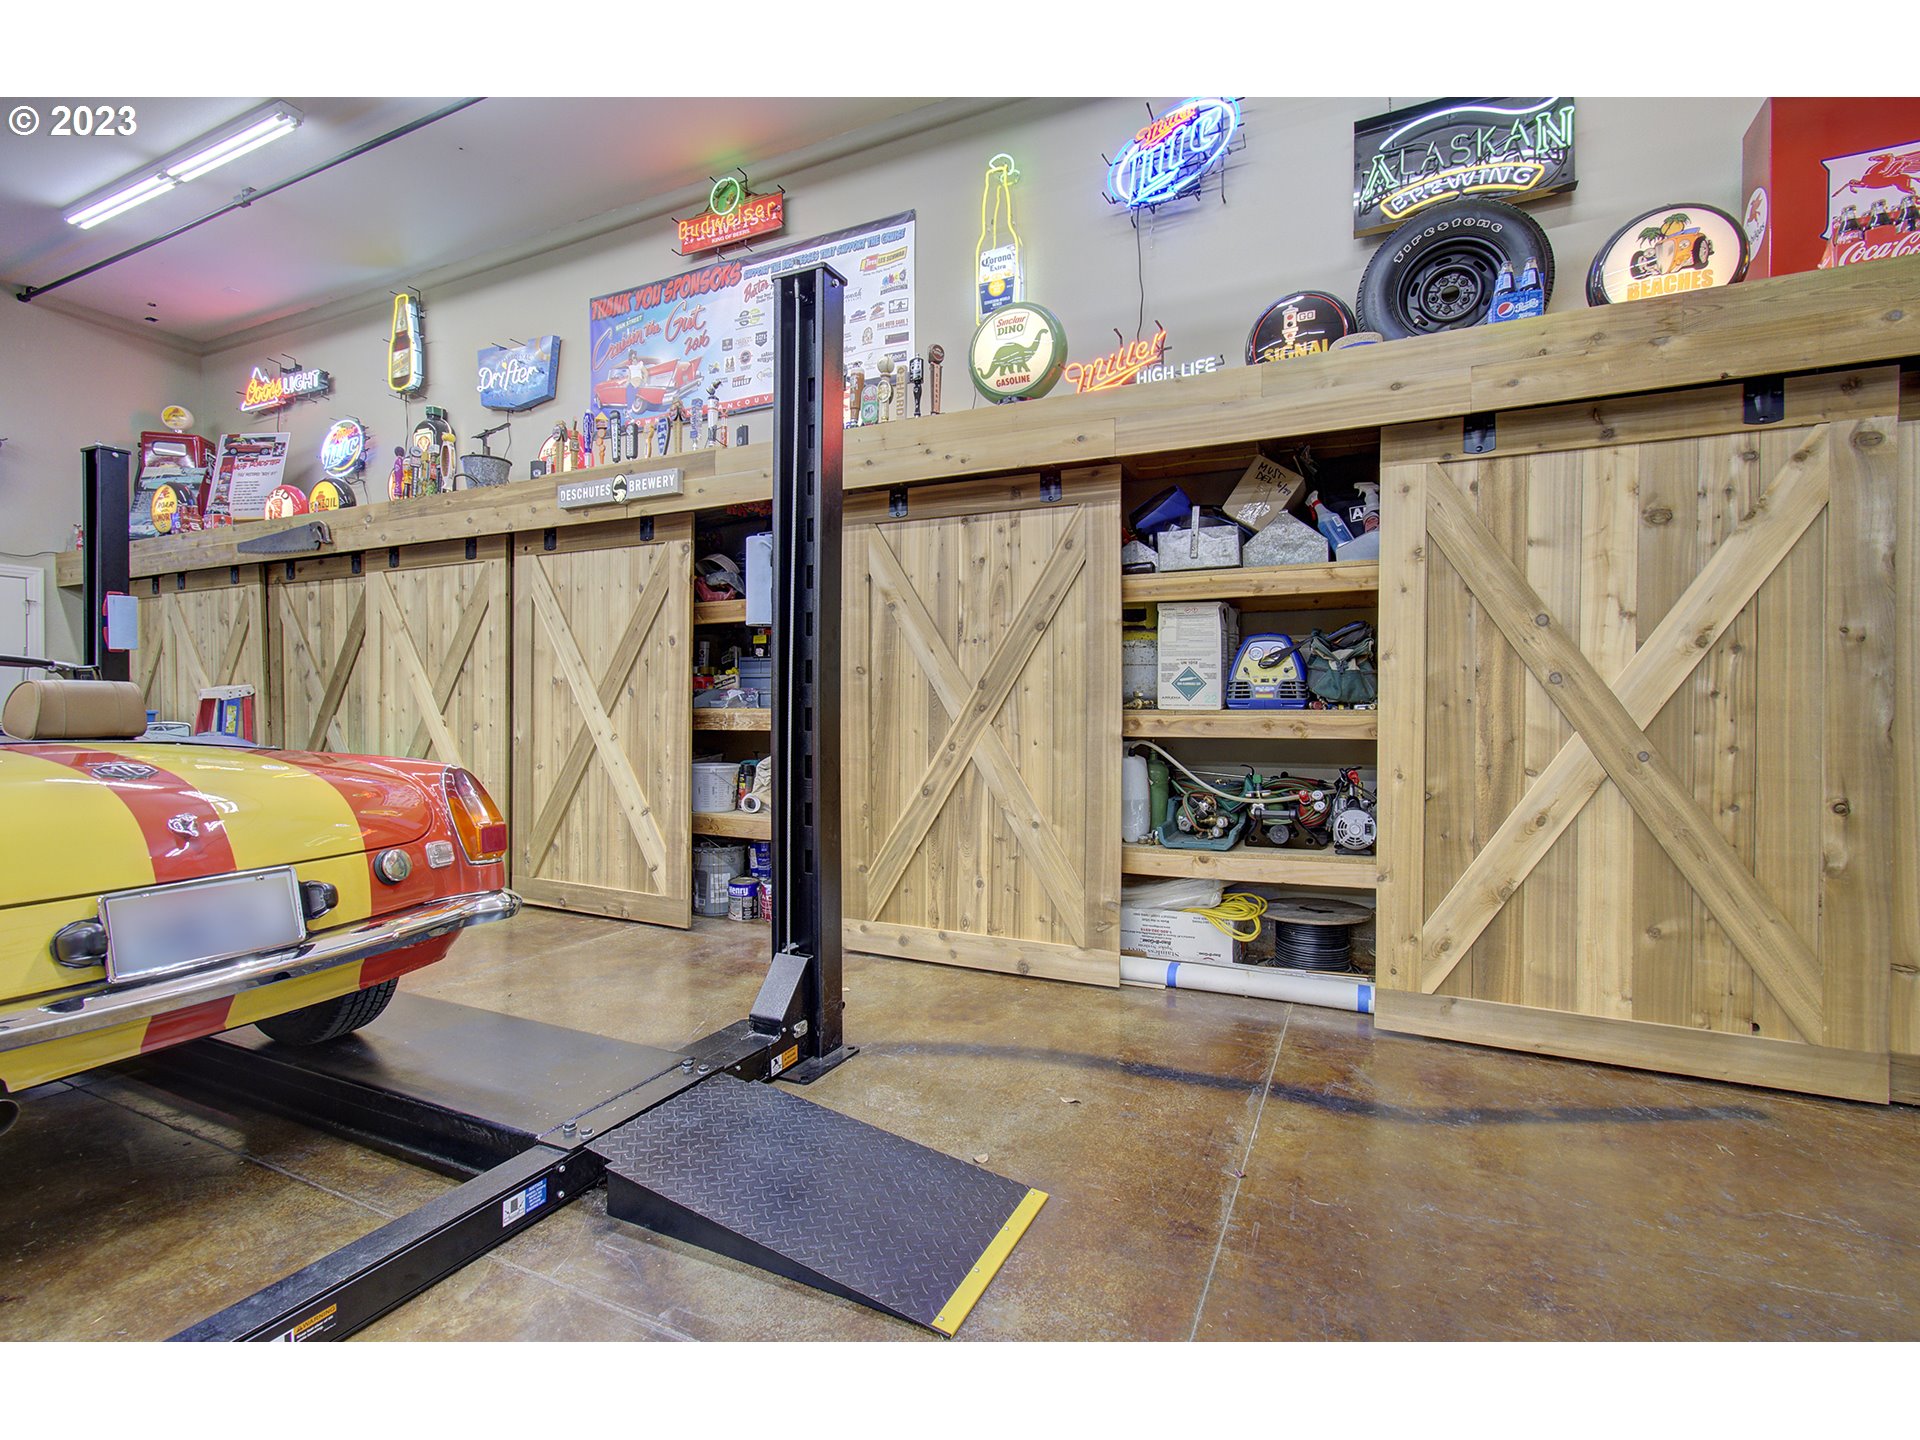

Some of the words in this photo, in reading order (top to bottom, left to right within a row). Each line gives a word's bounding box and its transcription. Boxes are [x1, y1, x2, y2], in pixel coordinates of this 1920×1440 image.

[1360, 107, 1574, 203] ALASKAN
[1391, 166, 1534, 212] BREWING
[678, 201, 776, 239] Budweiser
[867, 236, 880, 249] THE
[1838, 231, 1920, 267] Coca-Co
[981, 252, 1012, 267] Corona
[990, 264, 1006, 272] Extra
[591, 292, 632, 321] THANK
[634, 283, 662, 311] YOU
[664, 263, 743, 303] SPONSORS
[1627, 269, 1714, 301] BEACHES
[644, 320, 662, 338] the
[664, 300, 706, 343] Gut
[996, 315, 1026, 328] Sinclair
[997, 324, 1024, 336] DINO
[1300, 311, 1314, 320] GO
[477, 359, 539, 393] Drifter
[1064, 330, 1166, 394] Miller
[1136, 364, 1174, 384] HIGH
[1180, 357, 1216, 378] LIFE
[246, 377, 283, 405] Coors
[283, 369, 320, 395] LIGHT
[996, 374, 1031, 387] GASOLINE
[1258, 462, 1286, 479] MUST
[560, 484, 611, 502] DESCHUTES
[629, 474, 675, 492] BREWERY
[303, 1306, 336, 1326] WARNING
